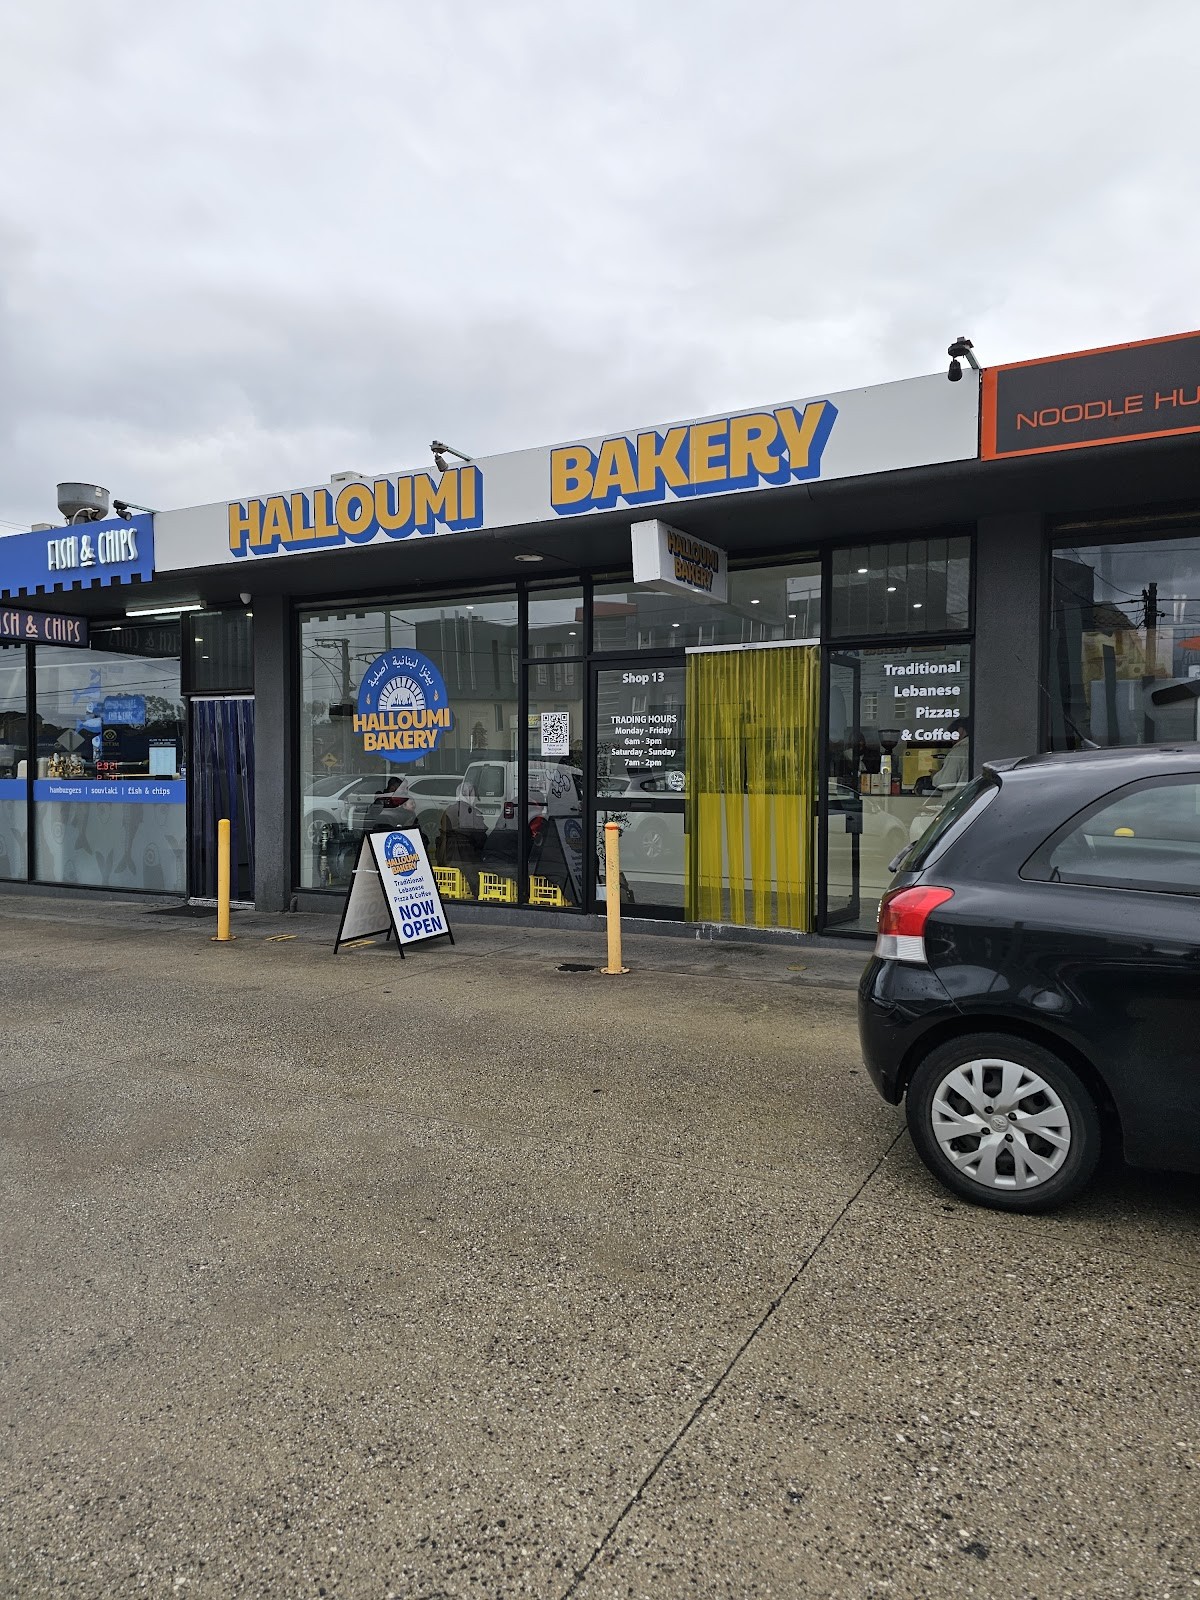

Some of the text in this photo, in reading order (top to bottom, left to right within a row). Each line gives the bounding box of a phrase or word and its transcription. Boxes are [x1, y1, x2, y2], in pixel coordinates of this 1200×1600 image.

[1016, 394, 1144, 430] NOODLE
[228, 400, 839, 557] HALLOUMI BAKERY
[47, 528, 139, 571] FISH & CHIPS
[667, 530, 719, 573] HALLOUMI
[674, 557, 714, 592] BAKERY
[0, 612, 81, 642] SH & CHIPS
[884, 660, 961, 676] Traditional
[622, 672, 665, 685] Shop 13
[894, 685, 960, 698] Lebanese
[611, 714, 677, 724] TRADING HOURS
[915, 706, 960, 719] Pizzas
[353, 707, 451, 733] HALLOUMI
[615, 727, 644, 735] Monday
[649, 726, 672, 735] Friday
[901, 728, 960, 740] & Coffee
[363, 729, 438, 752] BAKERY
[645, 738, 662, 746] 3pm
[611, 748, 643, 757] Saturday
[648, 748, 676, 757] Sunday
[645, 759, 662, 767] 2pm
[50, 786, 82, 795] hamburgers
[91, 786, 119, 795] souvlaki
[128, 786, 142, 795] fish
[145, 787, 150, 795] &
[152, 787, 170, 796] chips
[385, 853, 420, 868] HALLOUMI
[391, 861, 417, 875] BAKERY
[394, 876, 424, 886] Traditional
[398, 885, 424, 894] Lebanese
[414, 891, 432, 899] Coffee
[398, 900, 435, 921] NOW
[402, 916, 443, 938] OPEN
